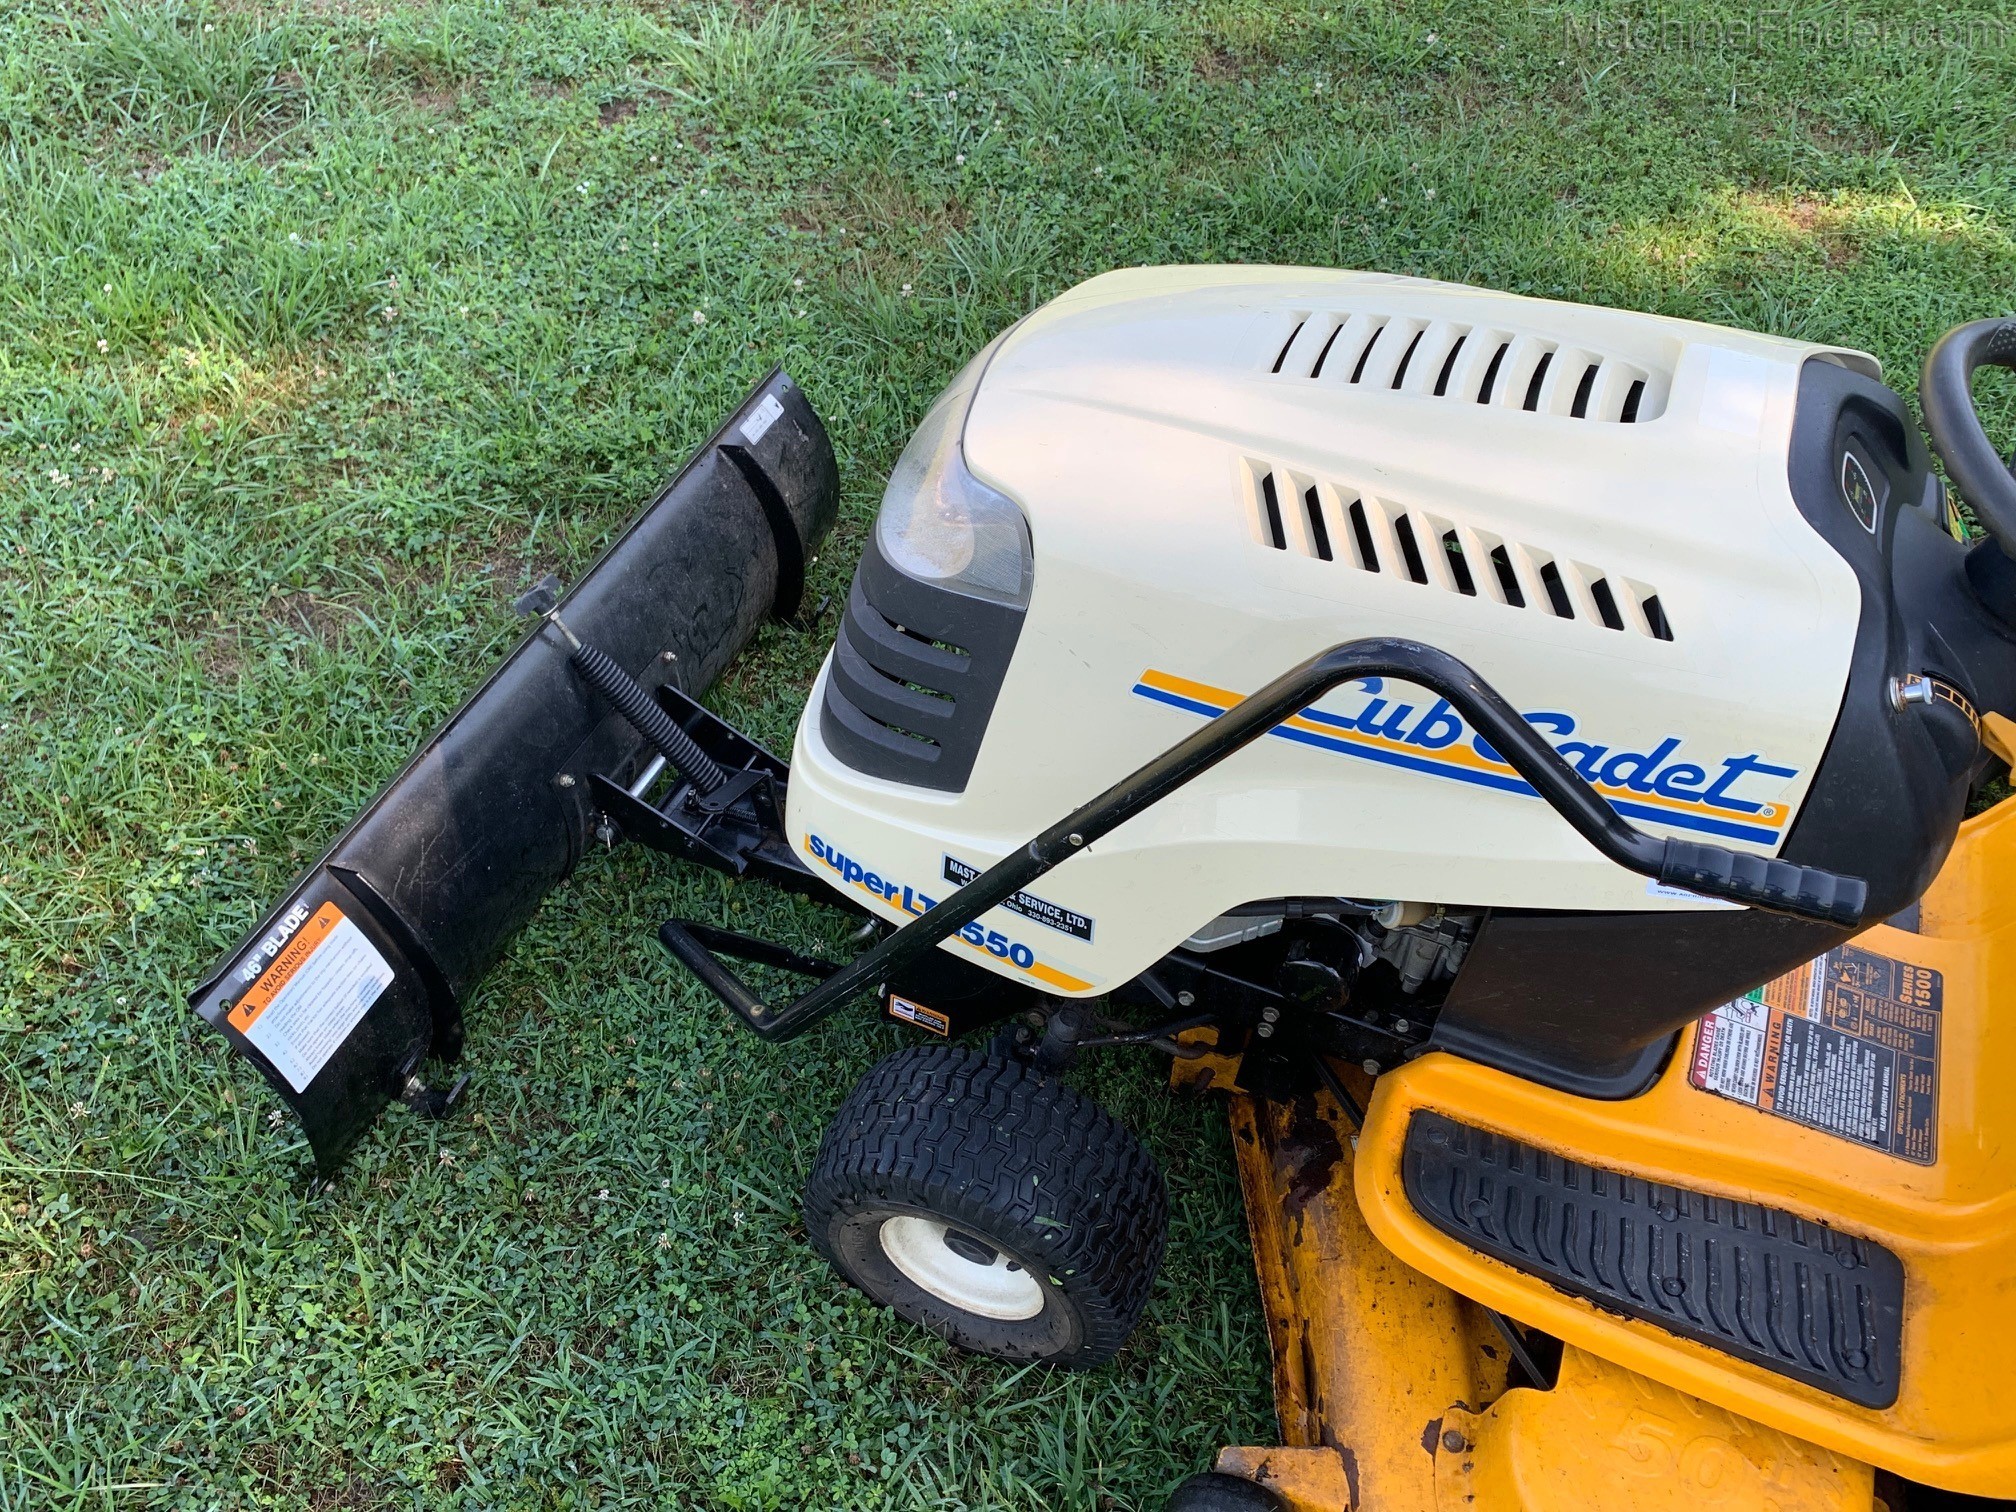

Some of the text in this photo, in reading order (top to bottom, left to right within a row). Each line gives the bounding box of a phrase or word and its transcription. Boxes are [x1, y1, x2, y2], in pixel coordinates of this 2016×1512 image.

[950, 860, 975, 881] MAST
[1018, 893, 1064, 922] SERVICE,
[1066, 913, 1088, 930] LTD.
[1006, 901, 1023, 913] Ohio
[242, 904, 310, 982] 46" BLADE
[260, 936, 311, 993] WARNING!
[270, 980, 286, 999] AVOID
[1899, 966, 1914, 1004] SERIES
[1915, 970, 1932, 1007] 1500
[1699, 1021, 1715, 1068] DANGER
[1764, 1021, 1782, 1085] WARNING
[1776, 1017, 1793, 1110] TO AVOID SERIOUS INJURY OR DEATH
